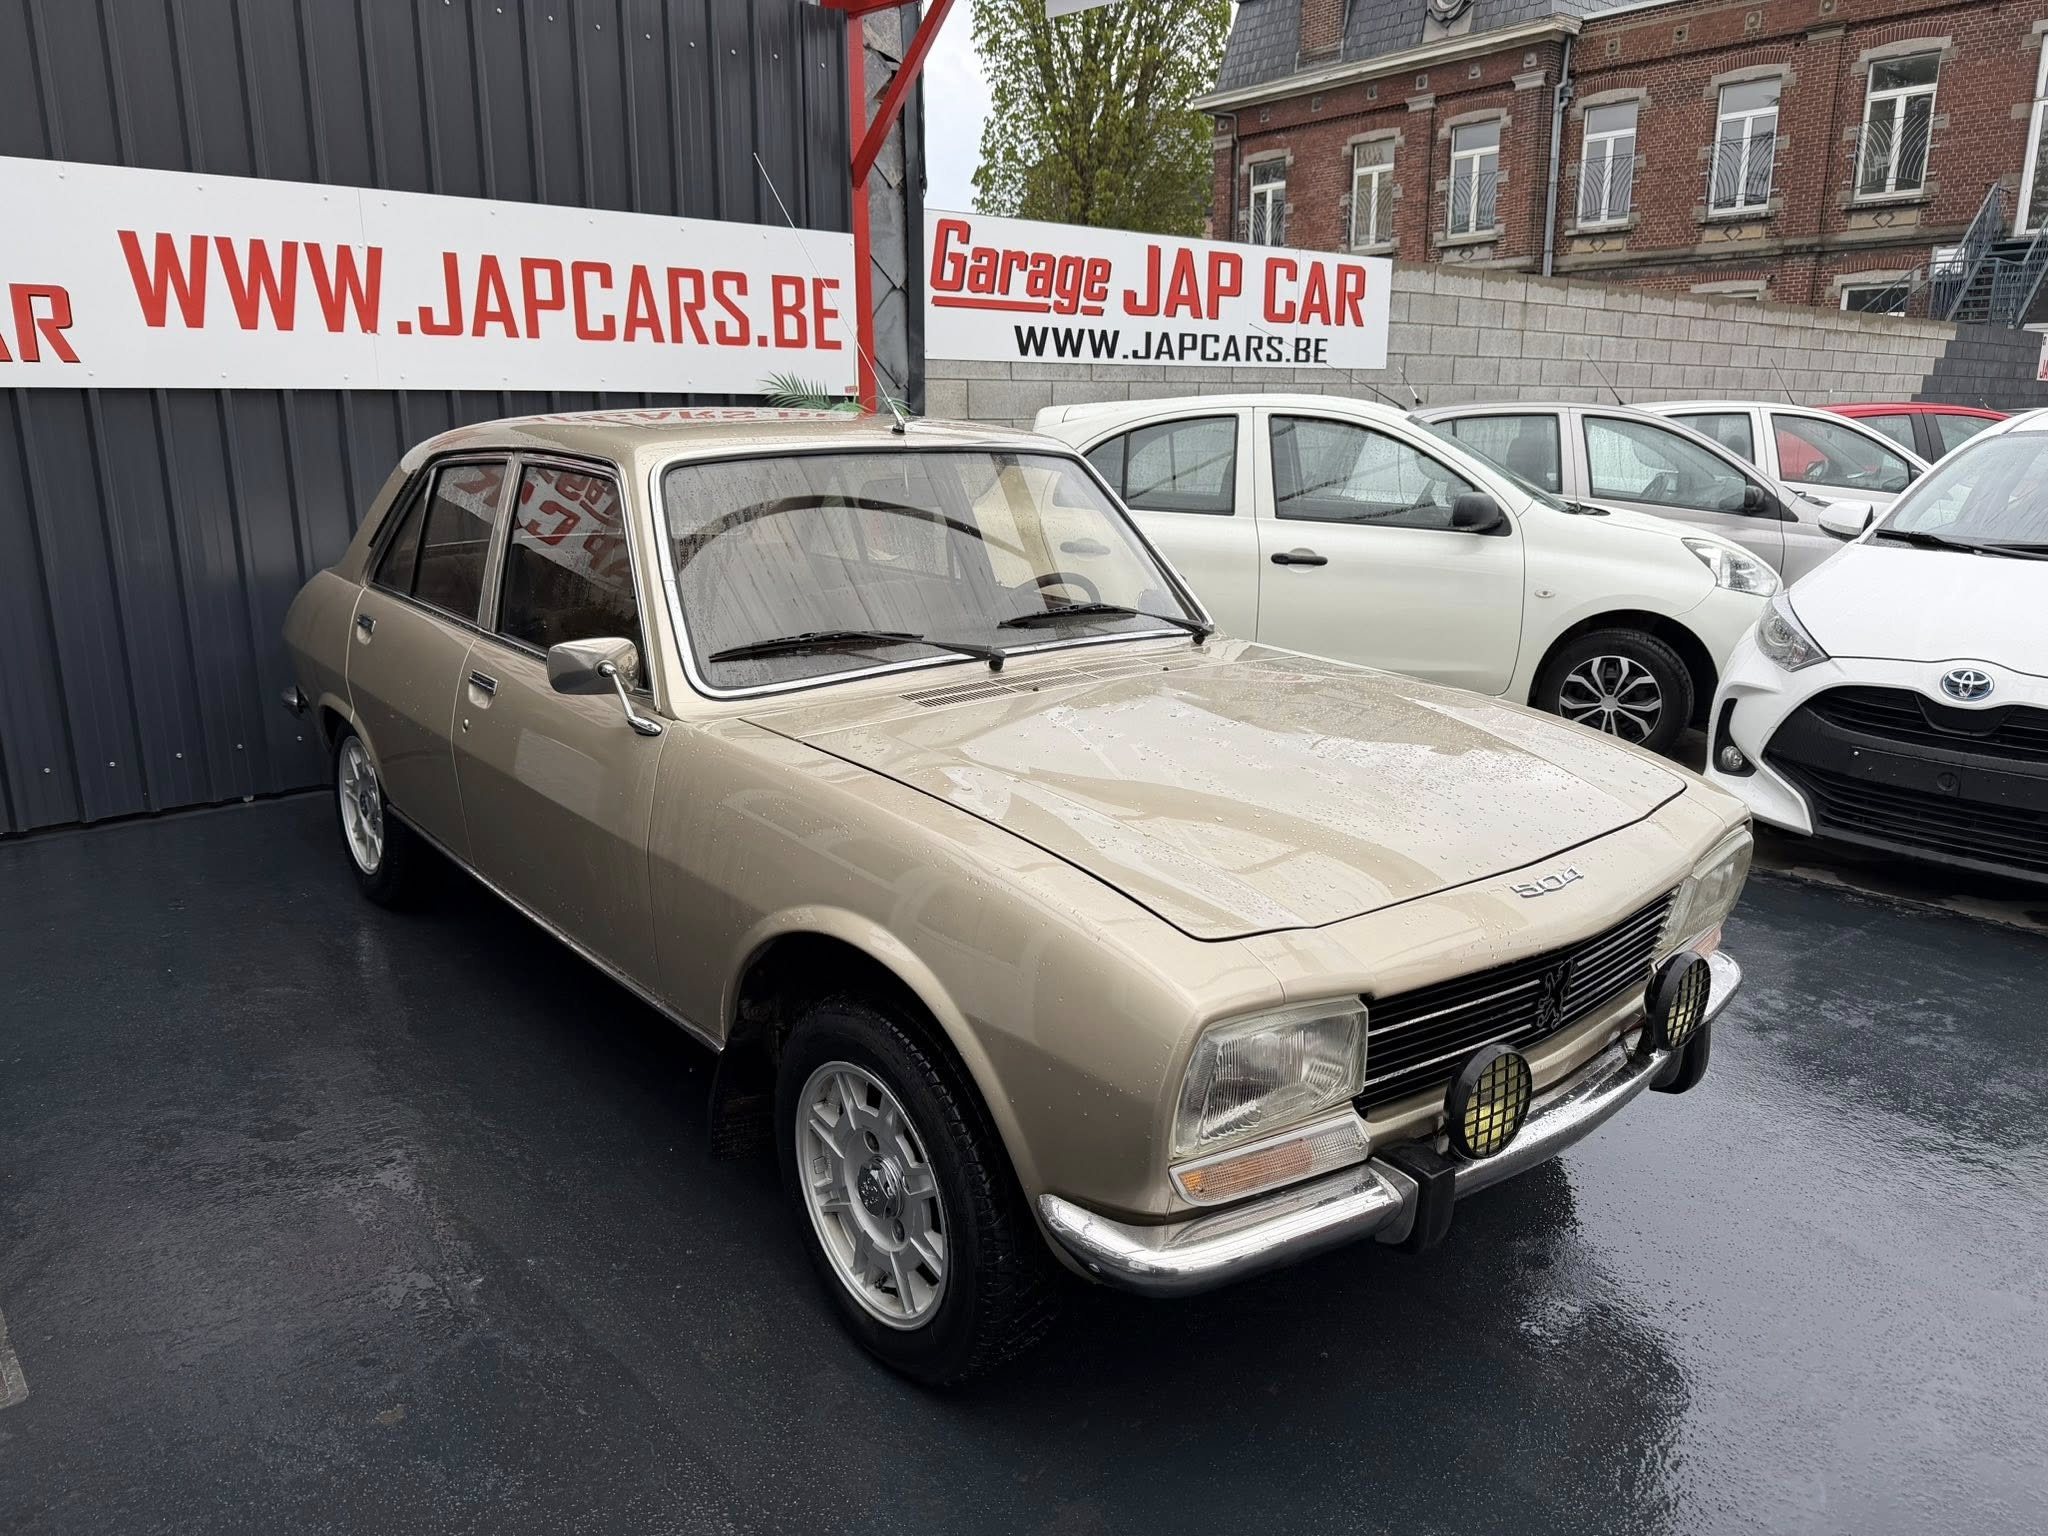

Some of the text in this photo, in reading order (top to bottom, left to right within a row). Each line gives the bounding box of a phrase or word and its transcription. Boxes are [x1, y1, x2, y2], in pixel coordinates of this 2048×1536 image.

[118, 230, 843, 351] WWW.JAPCARS.BE
[930, 218, 1367, 327] Garage JAP CAR
[0, 283, 81, 363] R
[1015, 325, 1328, 364] WWW.JAPCARS.BE
[1510, 865, 1584, 898] 504
